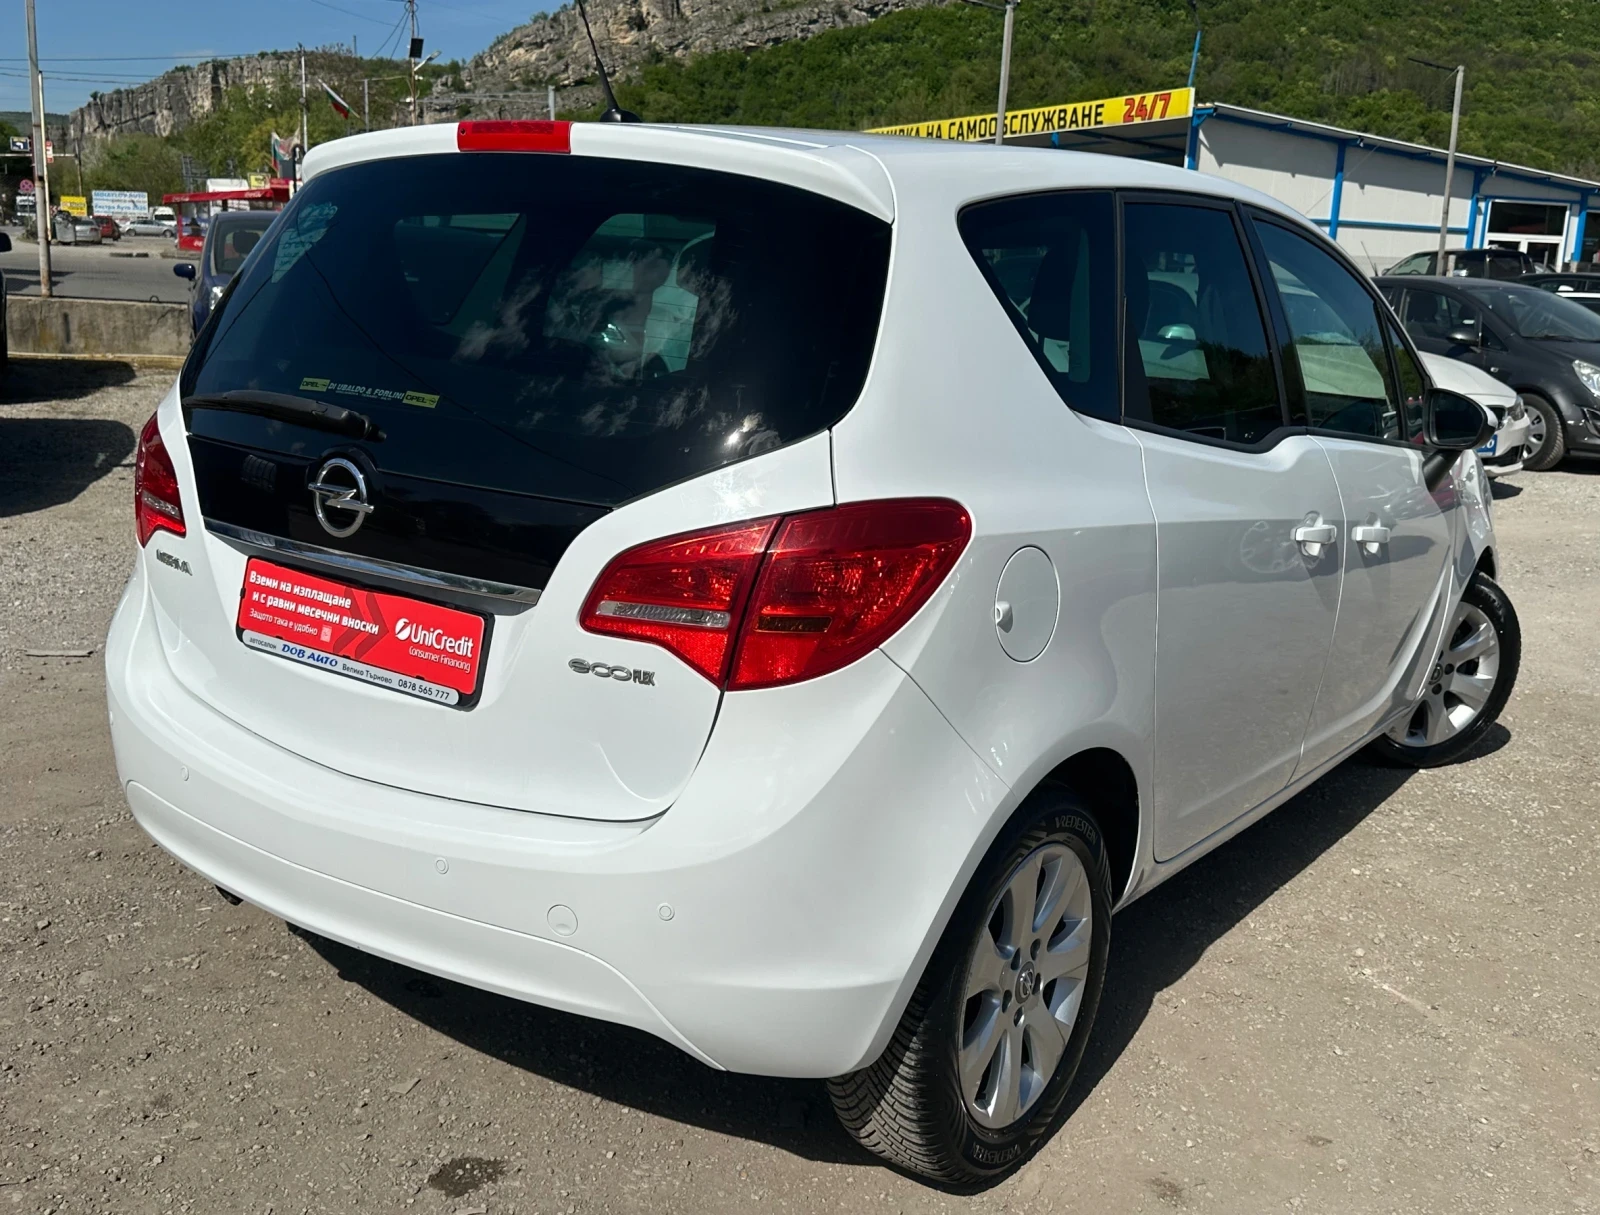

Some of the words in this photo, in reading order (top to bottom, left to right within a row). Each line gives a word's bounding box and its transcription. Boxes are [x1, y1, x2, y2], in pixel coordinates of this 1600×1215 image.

[1123, 93, 1172, 123] 24/7
[302, 380, 320, 388] OPEL
[328, 382, 337, 390] DI
[337, 383, 366, 394] UBALDO
[373, 388, 405, 400] FORLINI
[405, 394, 427, 404] OPEL
[249, 571, 279, 589] Вземи
[280, 582, 292, 593] на
[293, 584, 352, 609] изплащане
[249, 608, 273, 623] Защото
[273, 616, 288, 628] така
[288, 620, 293, 629] е
[293, 621, 318, 636] удобно
[252, 591, 260, 601] и
[260, 593, 266, 603] с
[266, 595, 296, 612] равни
[297, 604, 340, 624] месечни
[341, 615, 380, 635] вноски
[411, 623, 474, 658] UniCredit
[281, 643, 306, 659] DOB
[342, 663, 364, 676] Велико
[365, 669, 393, 684] Търново
[398, 678, 417, 691] 0878
[418, 685, 433, 696] 565
[435, 689, 450, 701] 777
[408, 646, 440, 663] Consumer
[440, 655, 471, 674] Financing
